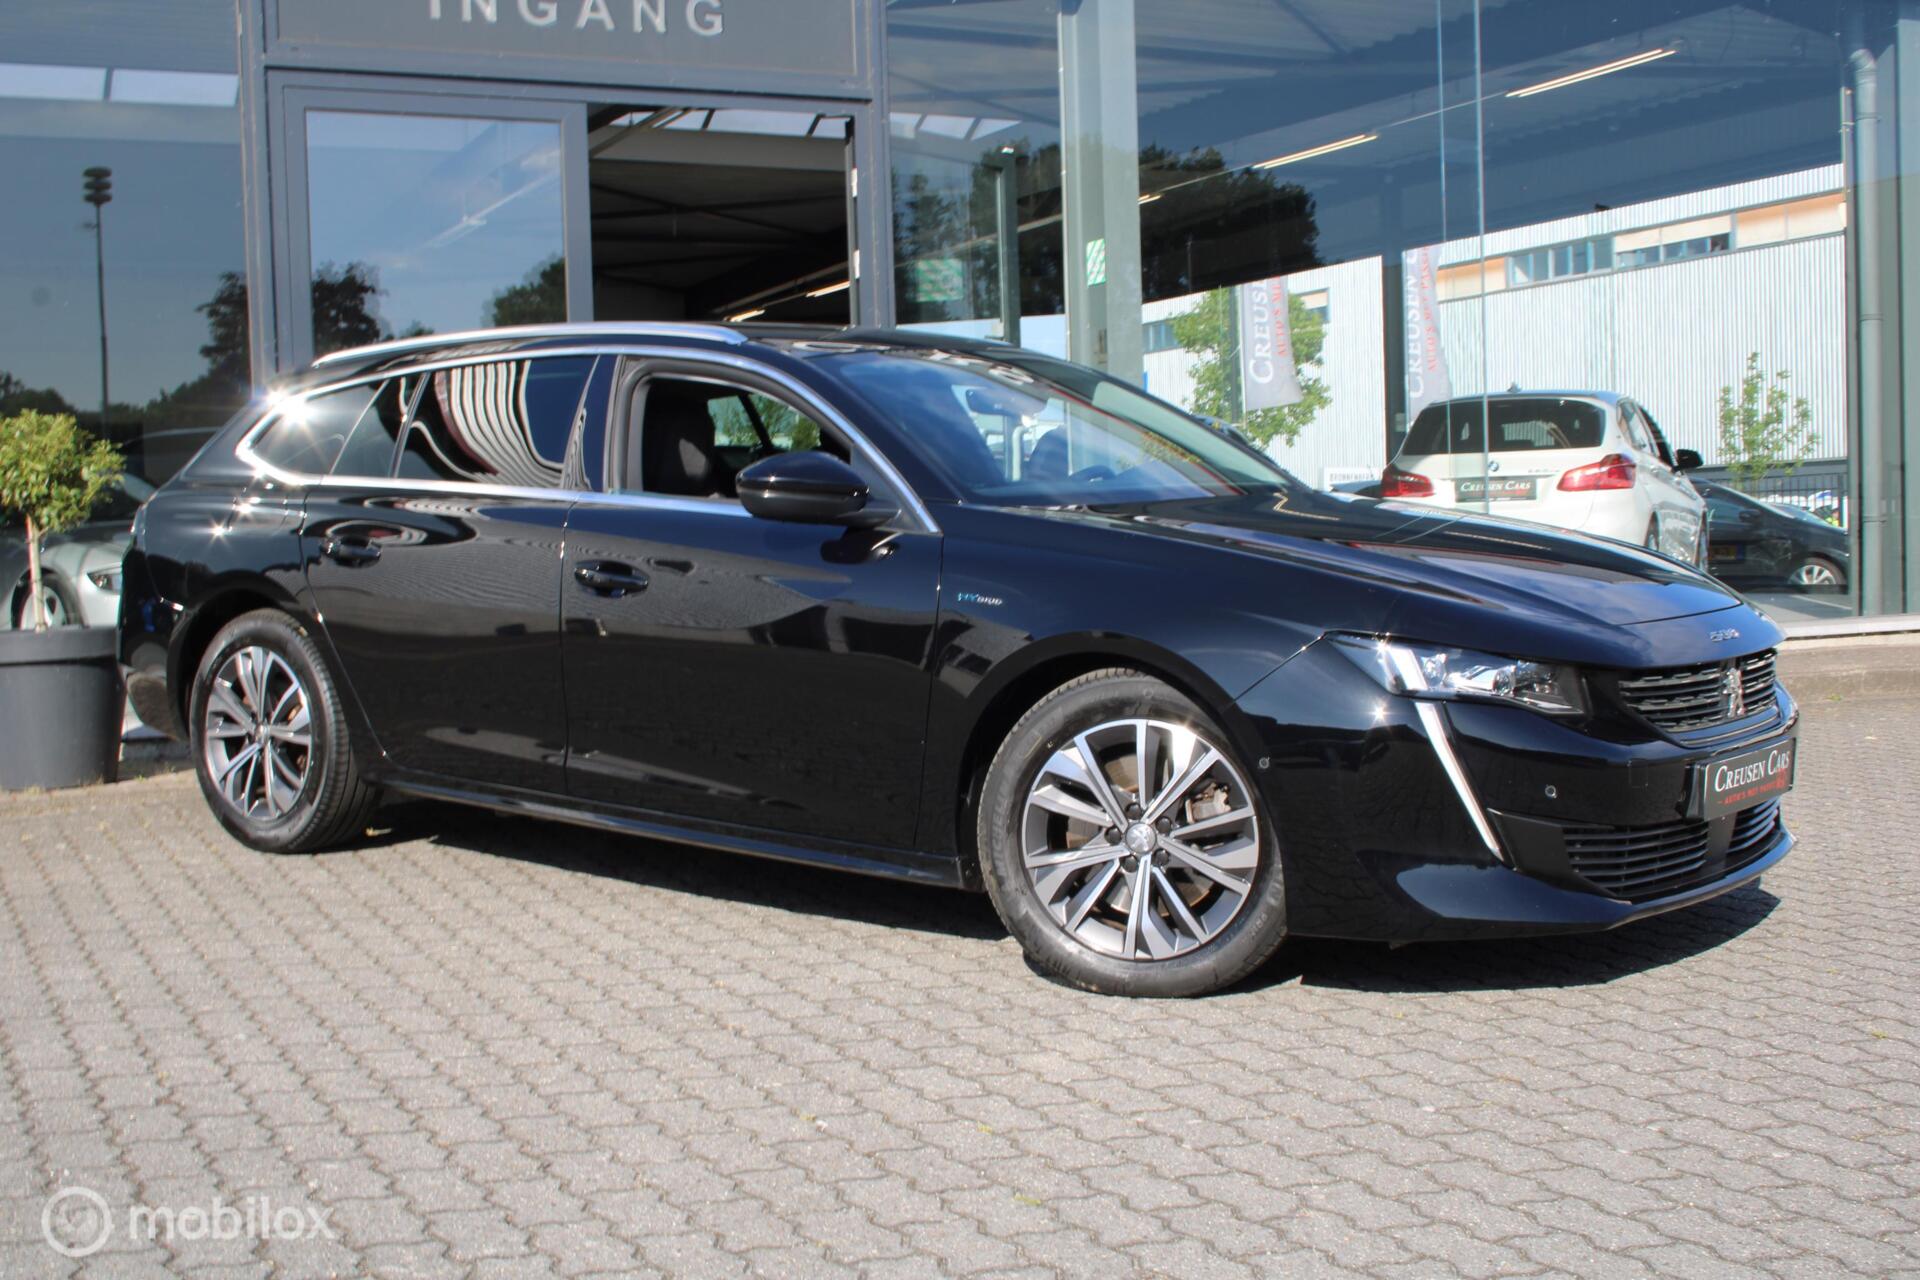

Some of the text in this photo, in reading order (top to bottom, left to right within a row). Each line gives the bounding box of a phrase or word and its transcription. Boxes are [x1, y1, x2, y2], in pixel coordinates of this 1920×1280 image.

[429, 0, 723, 36] INGANG
[1714, 760, 1766, 792] CREUSEN
[1767, 749, 1791, 775] CARS
